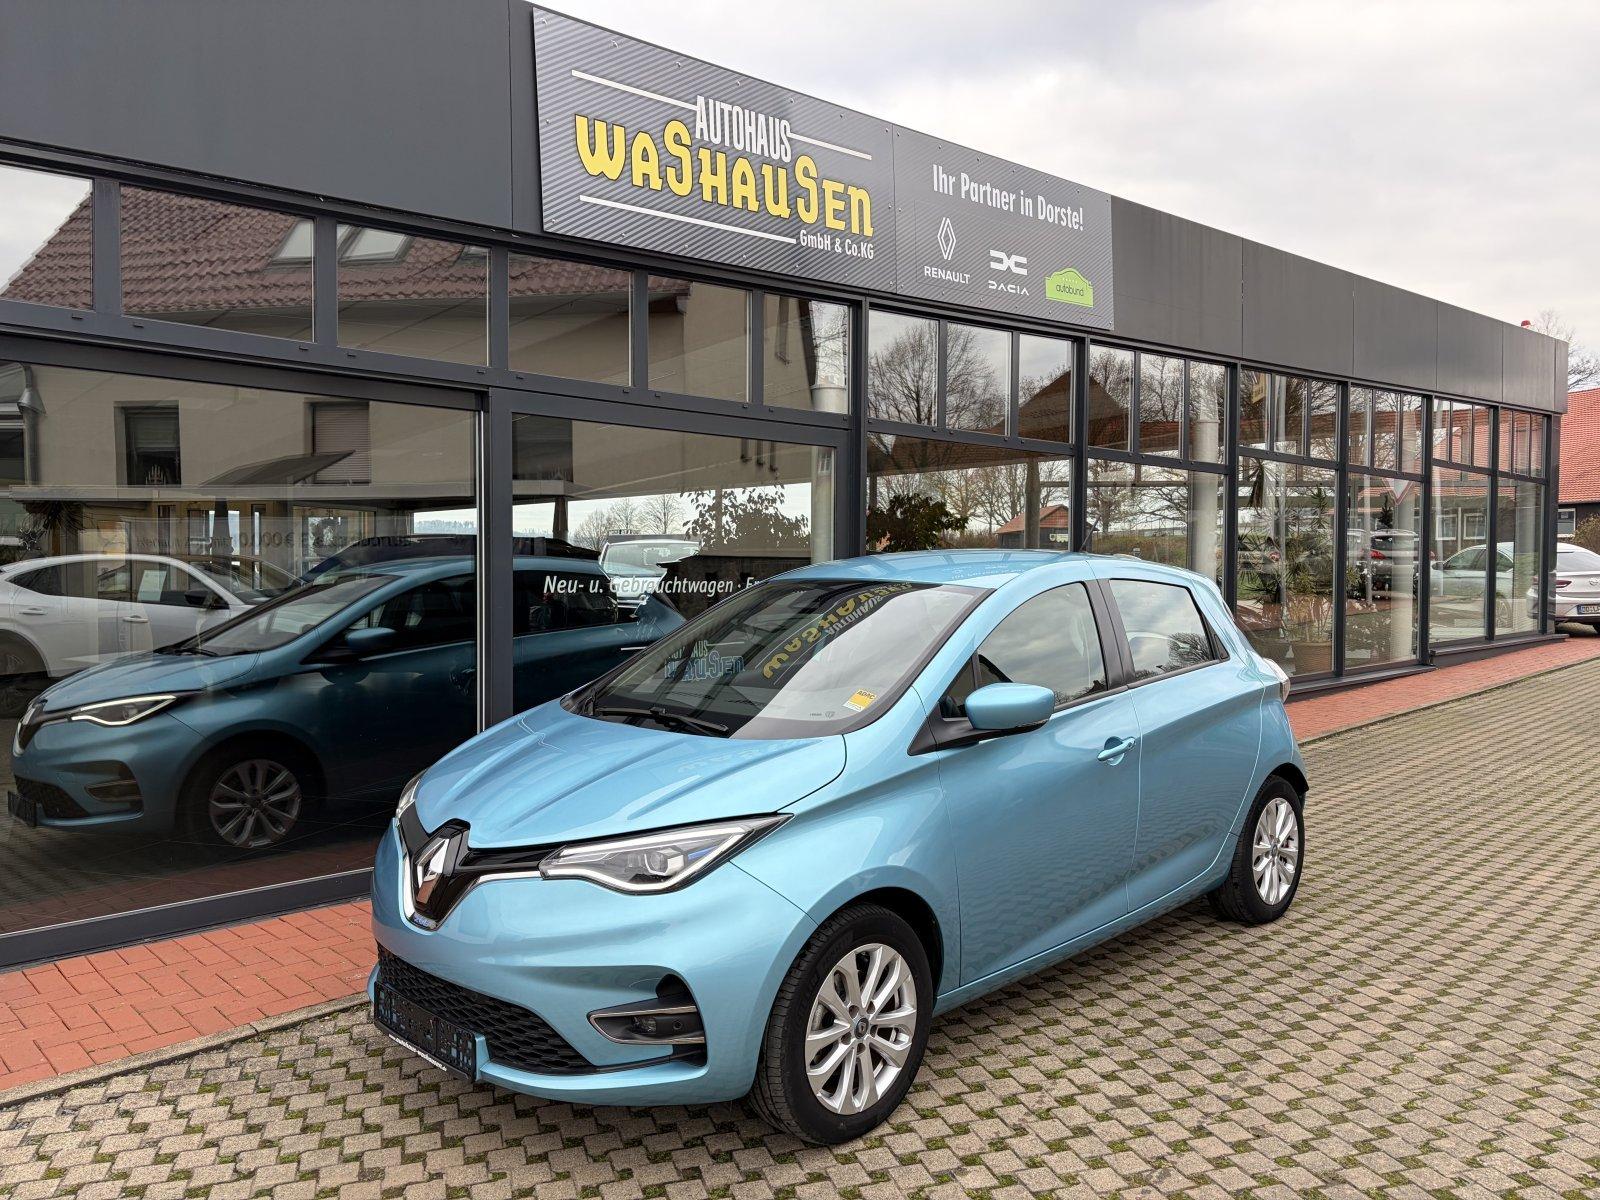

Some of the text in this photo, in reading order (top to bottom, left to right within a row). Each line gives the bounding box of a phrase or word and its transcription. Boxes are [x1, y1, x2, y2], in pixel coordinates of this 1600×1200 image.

[696, 95, 792, 163] AUTOHAUS
[933, 164, 1084, 231] Ihr Partner in Dorste!
[800, 229, 831, 251] GmbH
[834, 237, 842, 254] &
[924, 266, 971, 285] RENAULT
[988, 280, 1030, 296] DACIA
[1055, 284, 1084, 297] autobund
[543, 575, 584, 594] Neu-
[589, 579, 604, 594] u.
[609, 576, 733, 598] Gebrauchtwagen
[856, 690, 876, 700] ADAC
